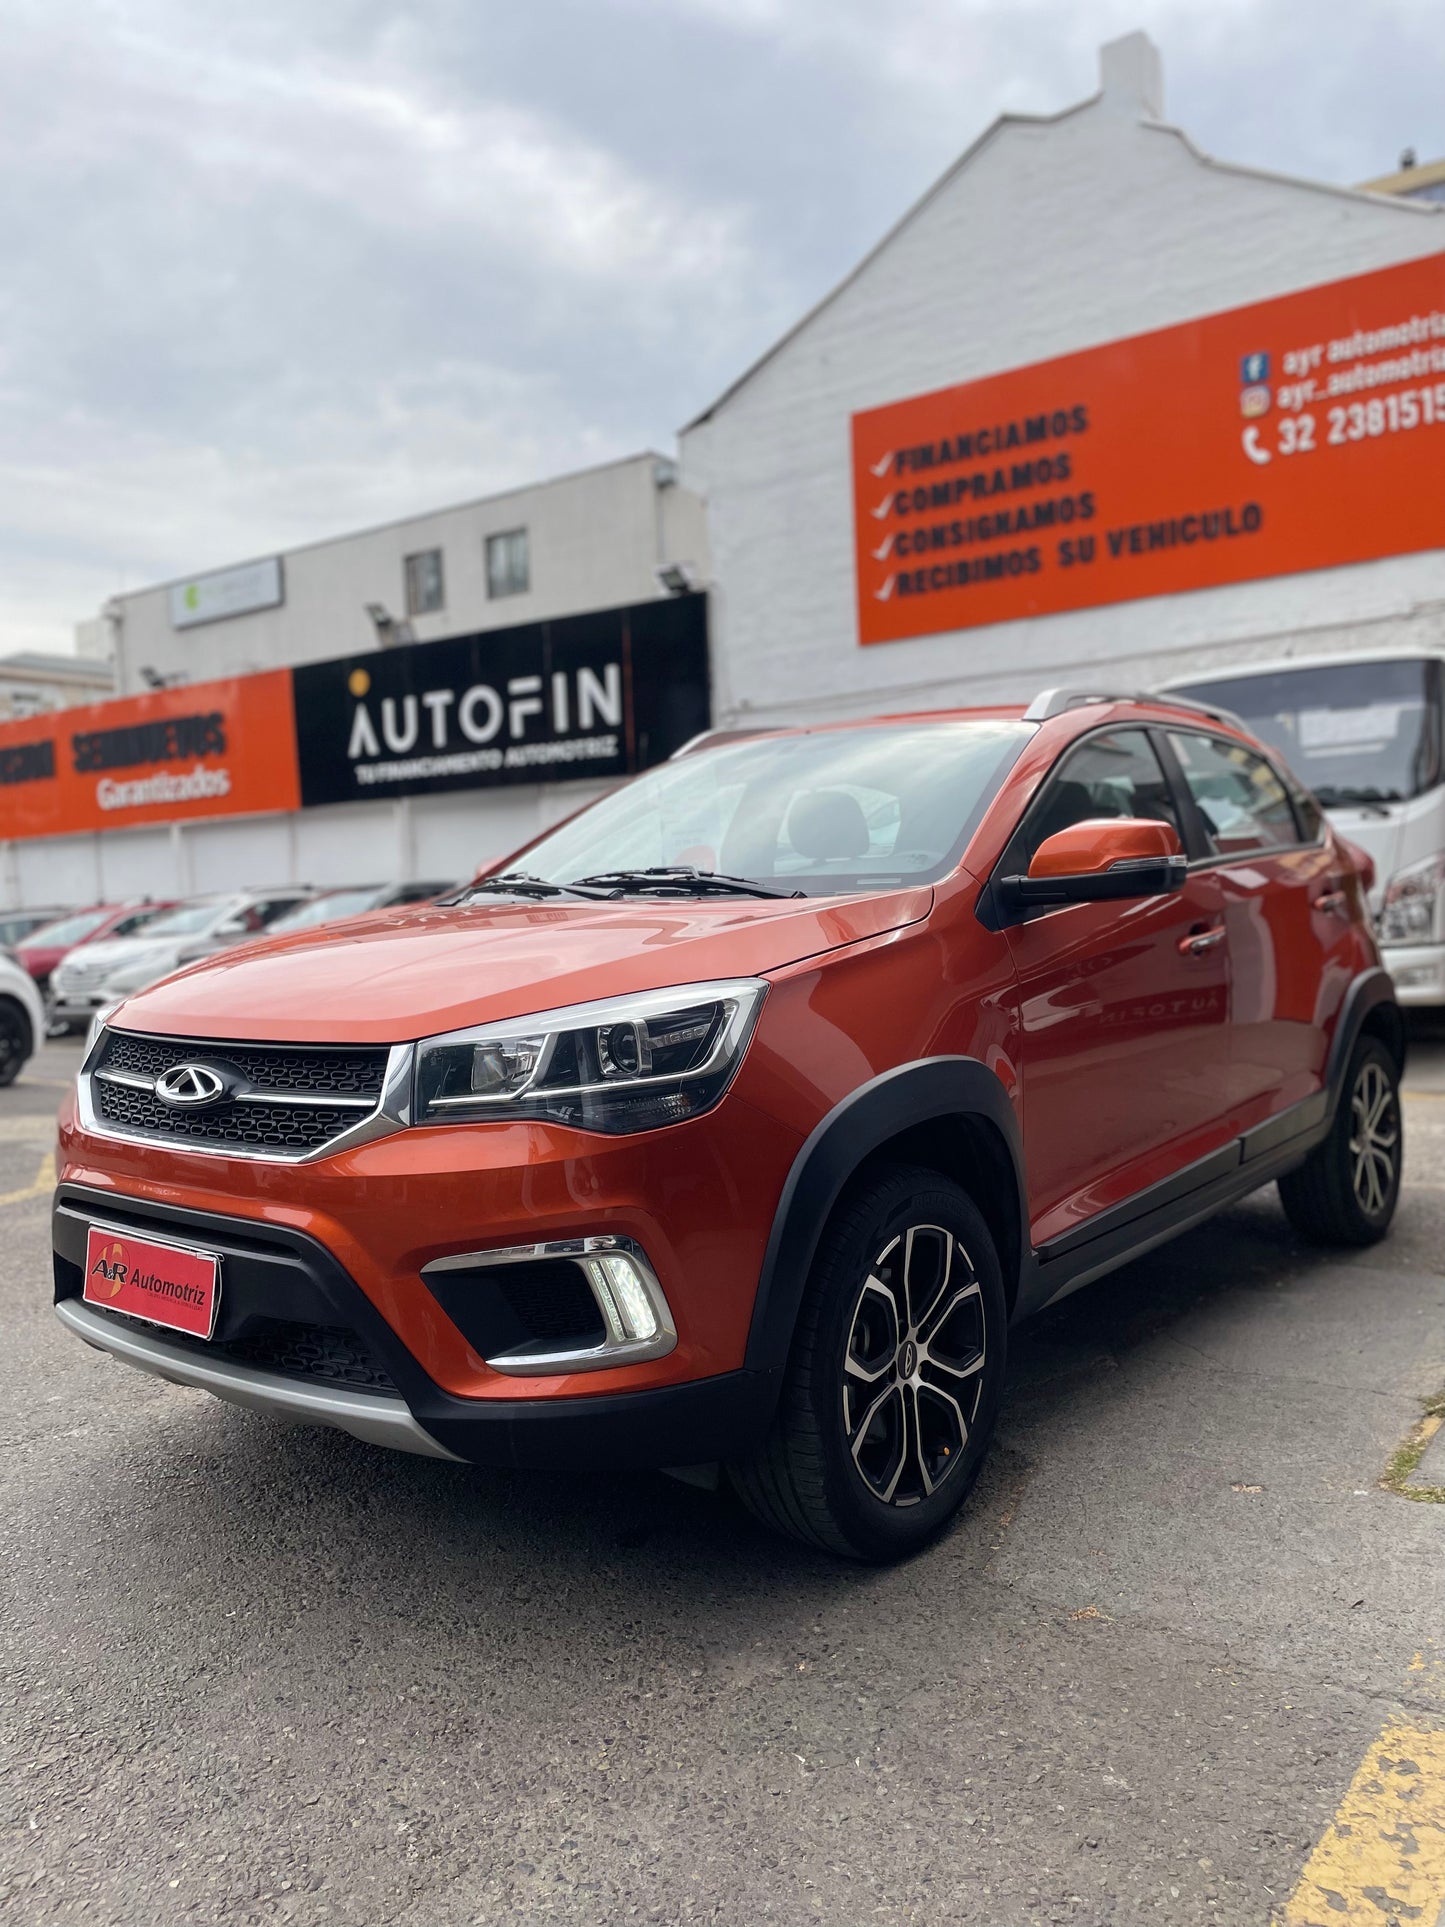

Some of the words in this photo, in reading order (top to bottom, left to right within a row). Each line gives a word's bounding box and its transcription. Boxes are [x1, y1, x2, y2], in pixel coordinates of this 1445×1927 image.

[895, 405, 1088, 475] FINANCIAMOS
[1278, 414, 1316, 455] 32
[895, 453, 1072, 516] COMPRAMOS
[895, 492, 1095, 557] CONSIGNAMOS
[897, 546, 1041, 596] RECIBIMOS
[1058, 536, 1096, 568] SU
[1107, 503, 1263, 558] VEHICULO
[348, 663, 621, 758] AUTOFIN
[505, 735, 619, 768] AUTOMOTRIZ
[97, 765, 231, 810] Garantizados
[130, 1269, 206, 1306] Automotriz
